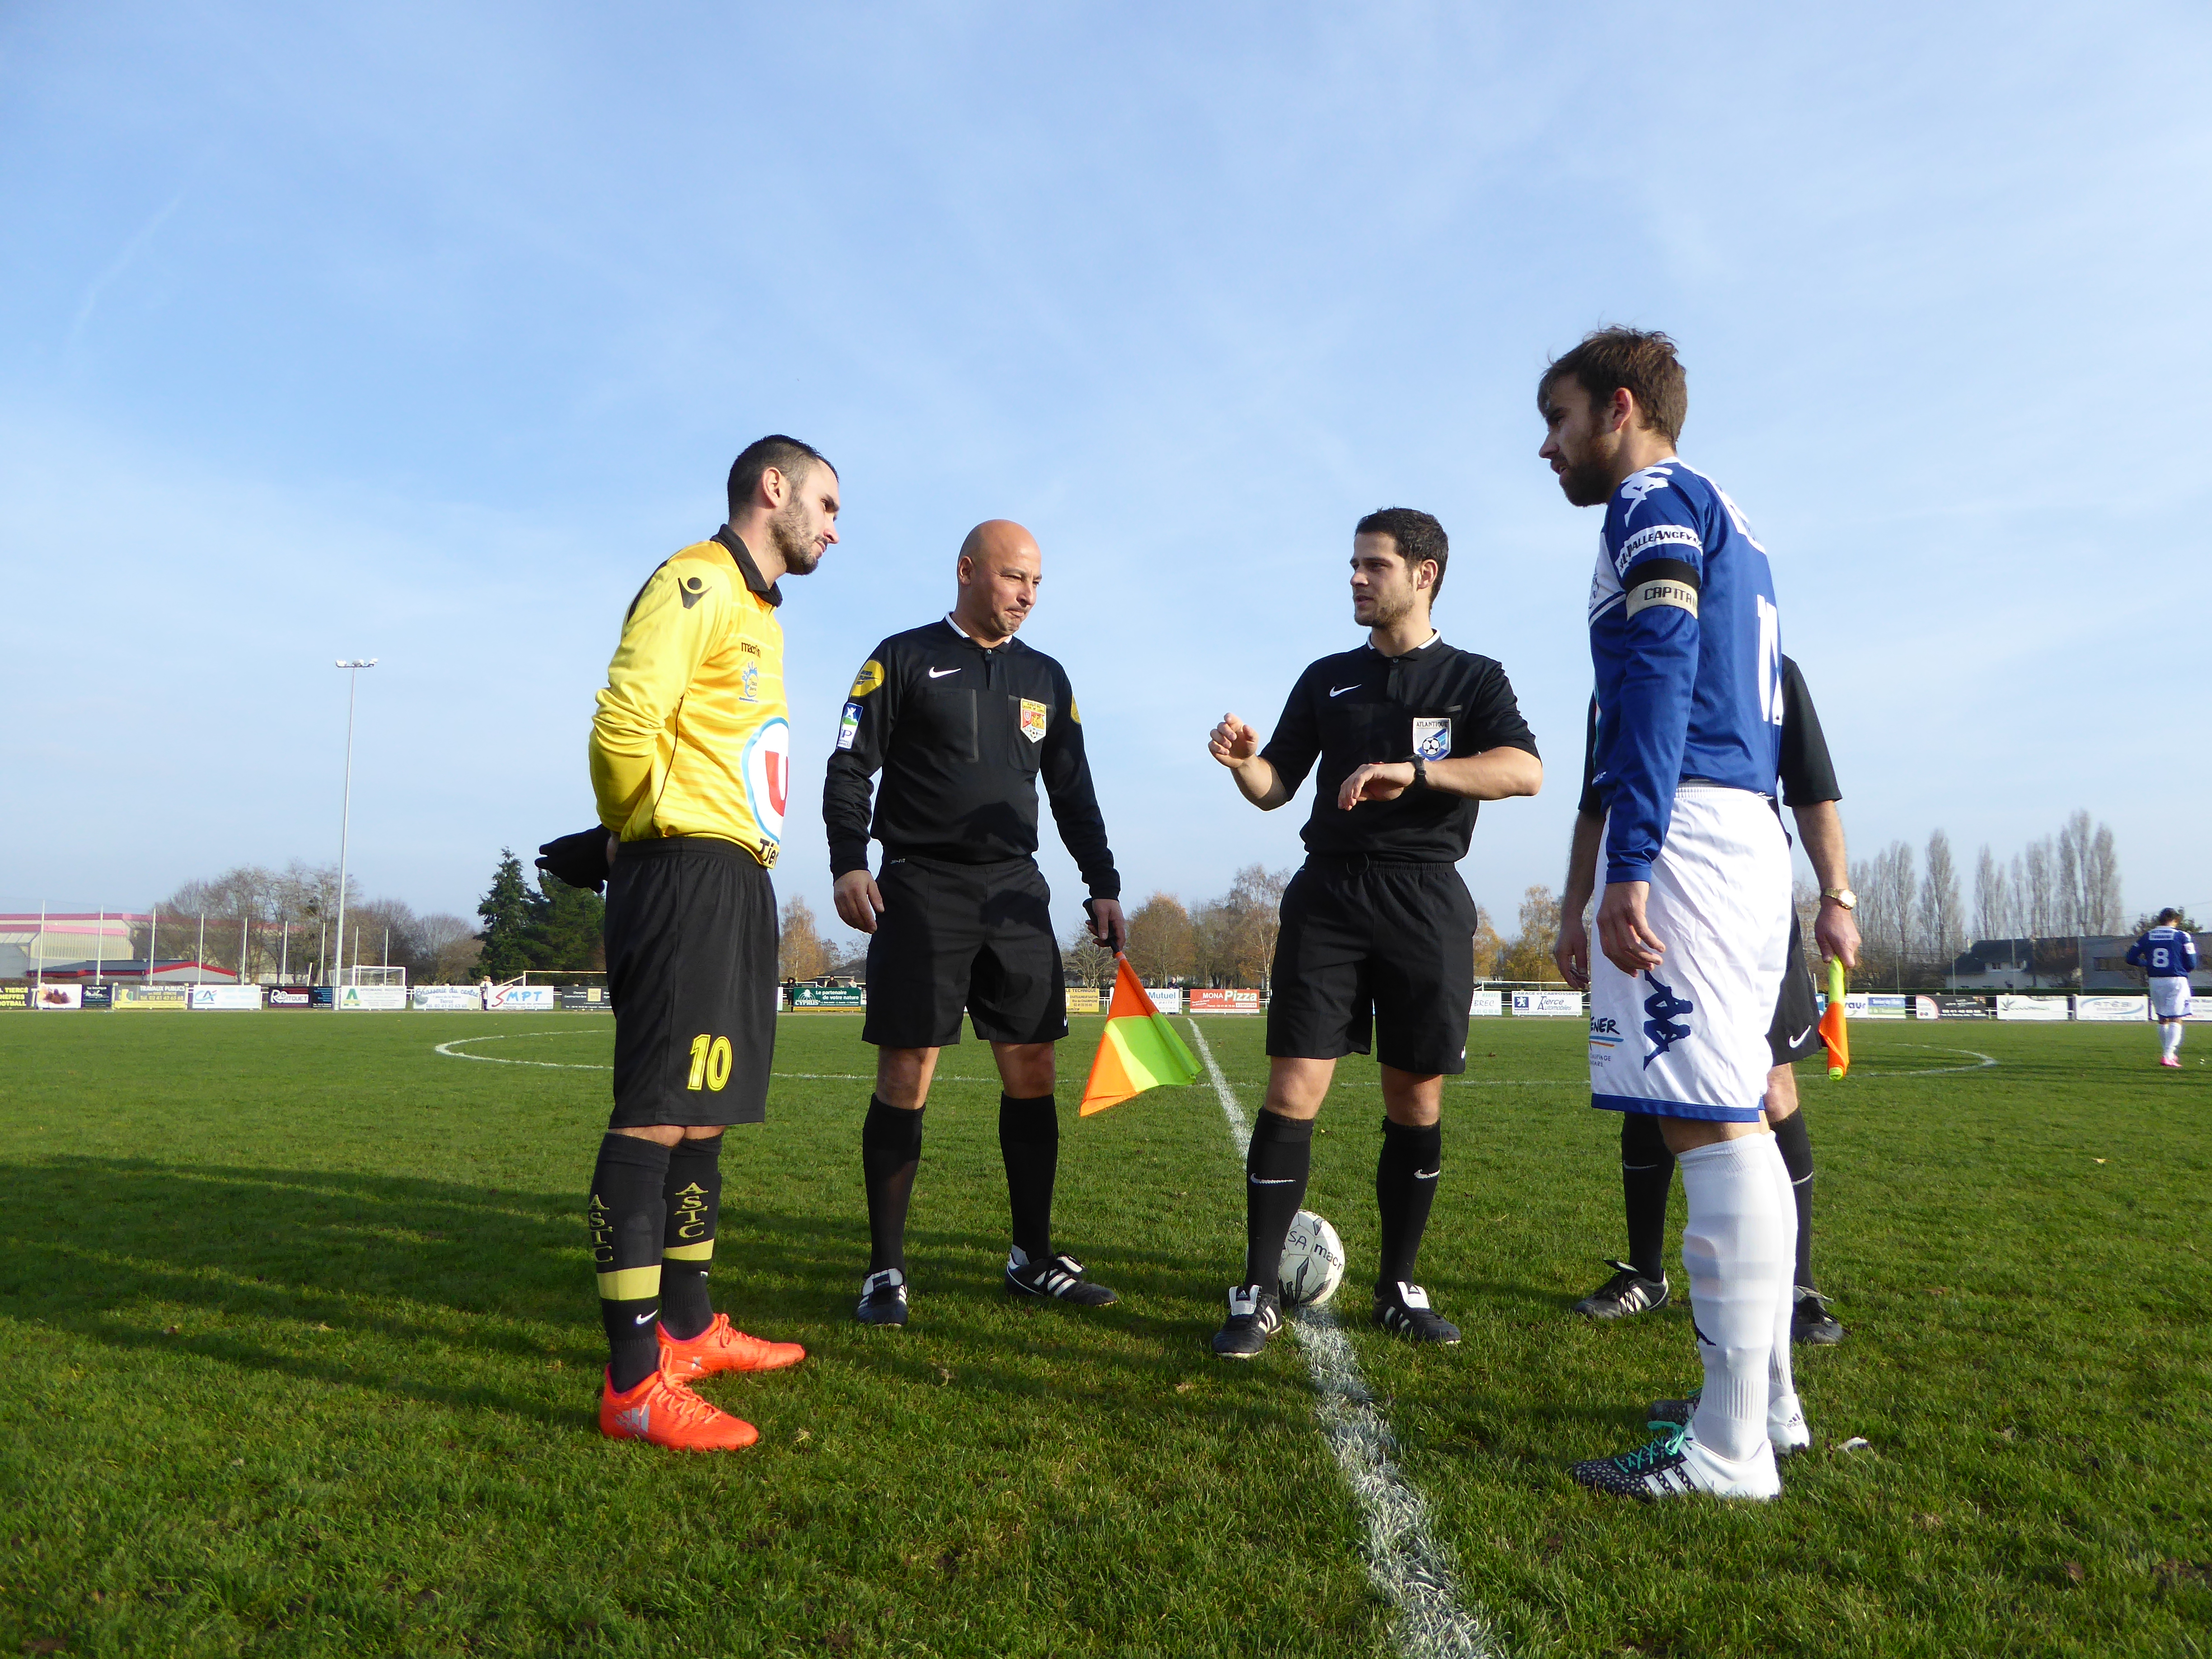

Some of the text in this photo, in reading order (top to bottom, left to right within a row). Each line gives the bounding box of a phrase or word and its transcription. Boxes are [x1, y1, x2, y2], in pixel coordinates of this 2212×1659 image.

[2152, 947, 2169, 968] 8
[1224, 990, 1257, 1001] Pizza
[687, 1034, 732, 1091] 10
[1314, 1243, 1344, 1270] macr
